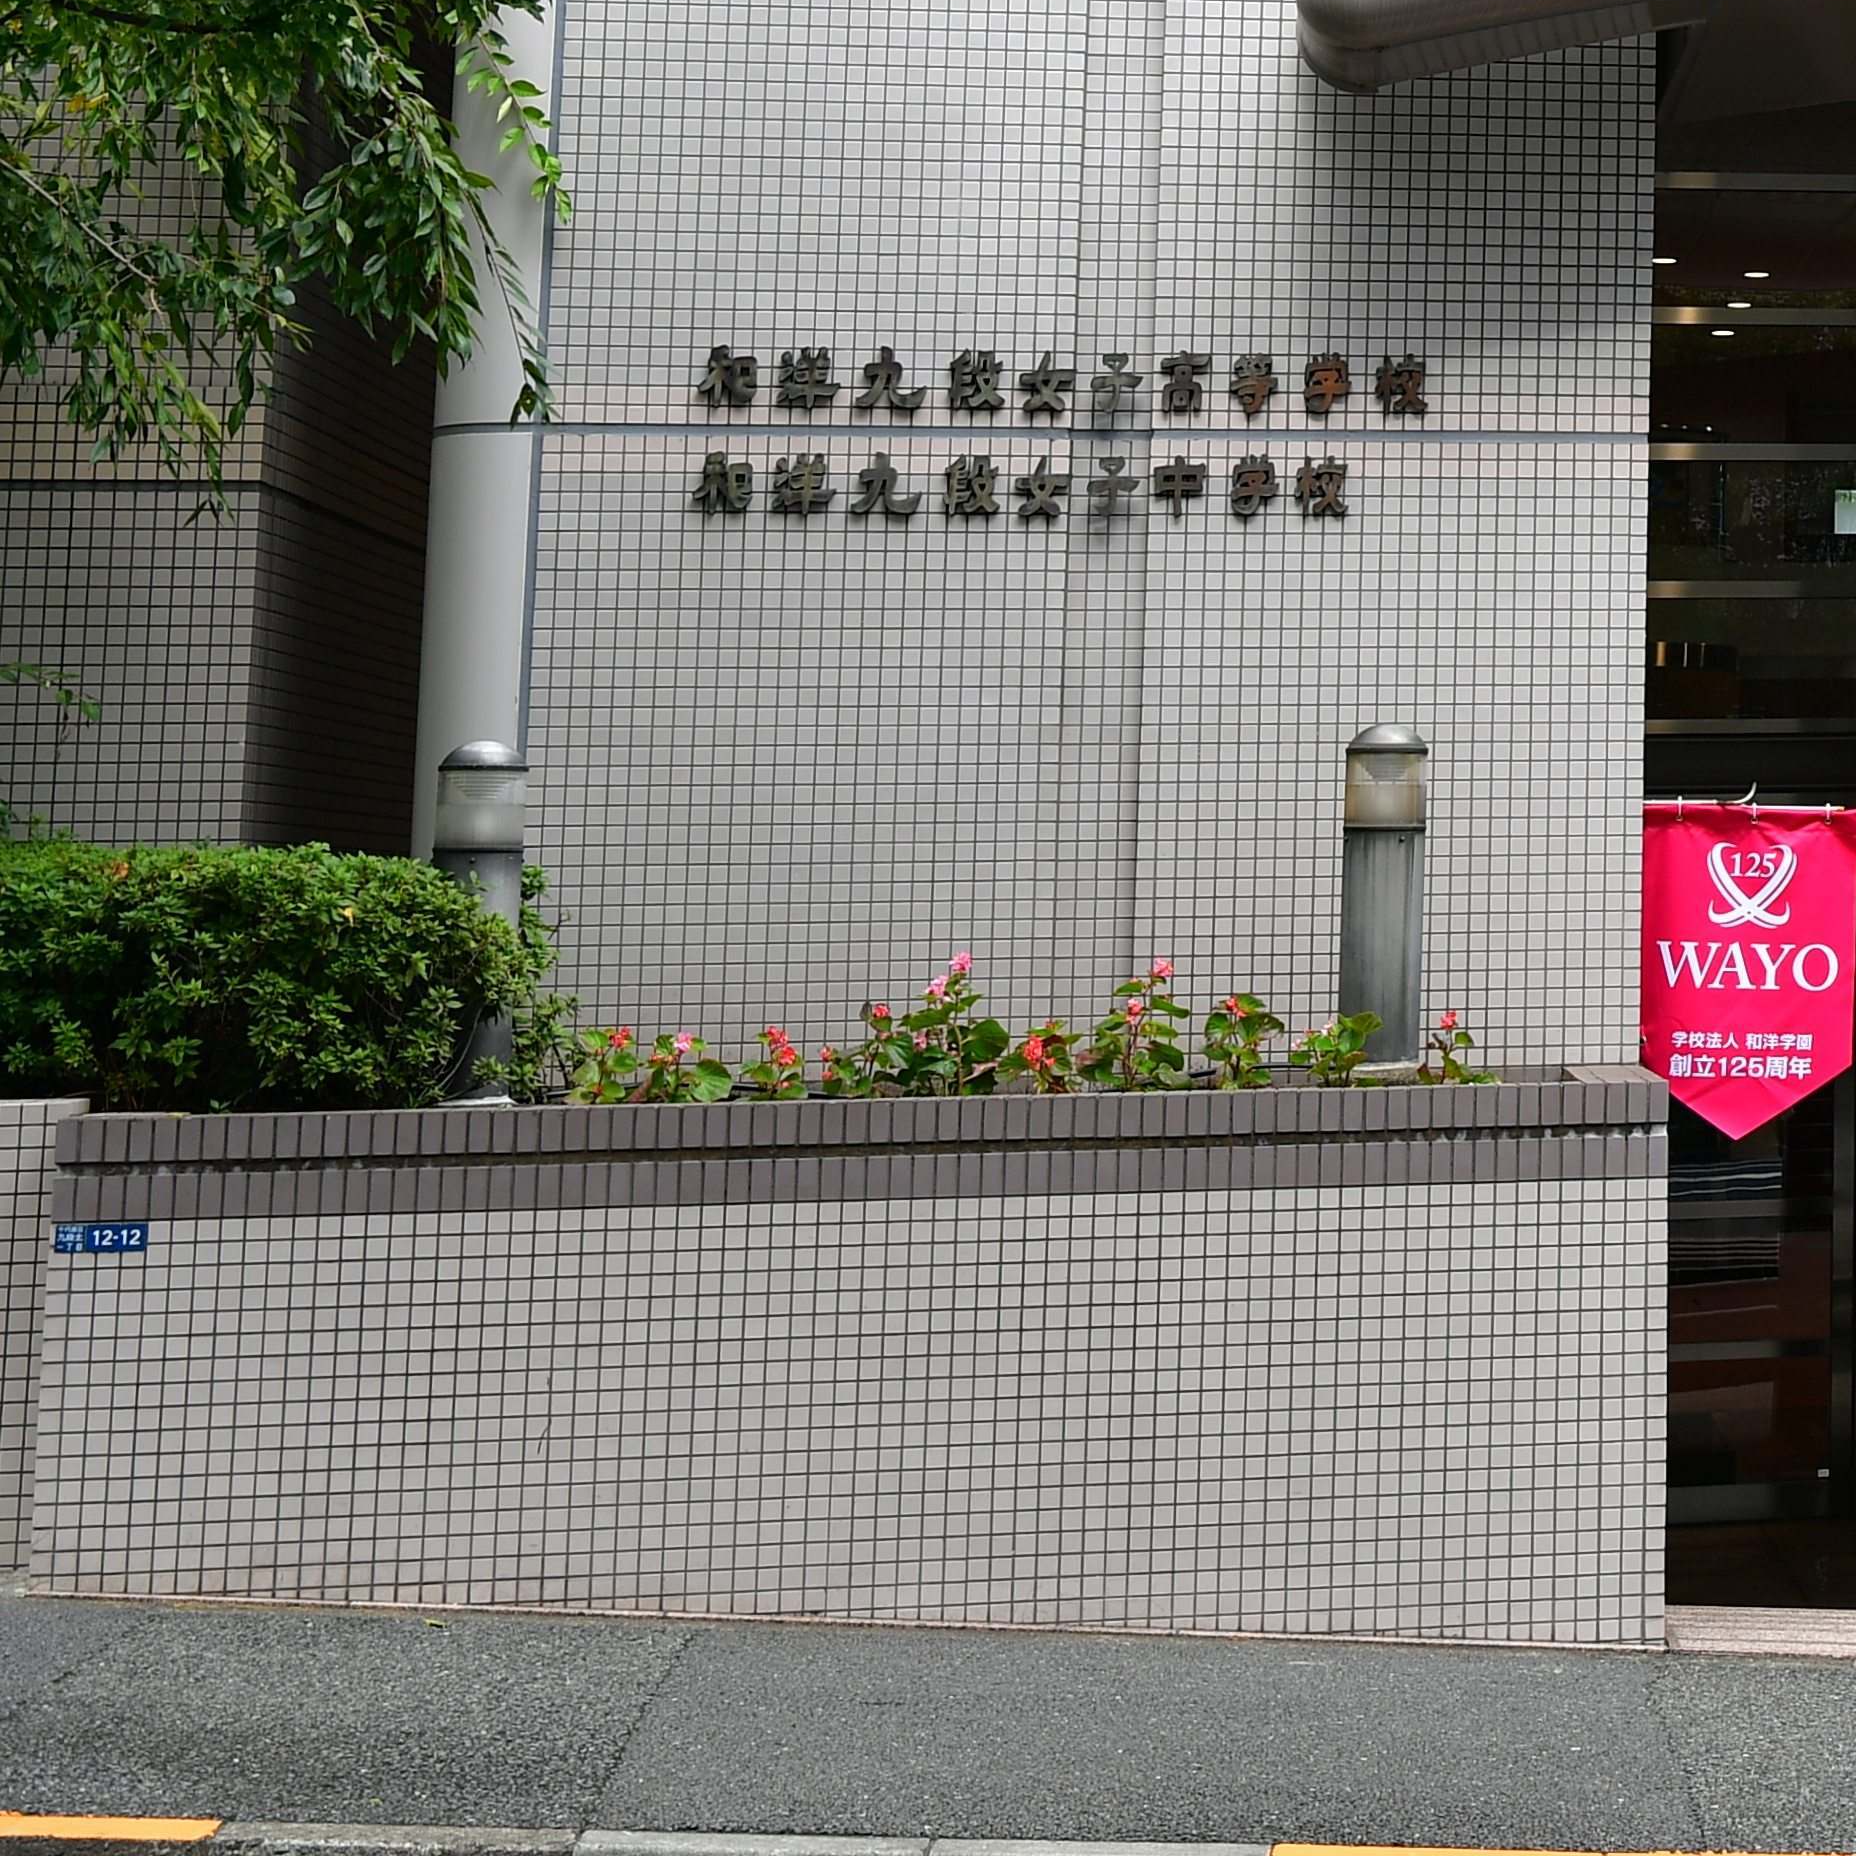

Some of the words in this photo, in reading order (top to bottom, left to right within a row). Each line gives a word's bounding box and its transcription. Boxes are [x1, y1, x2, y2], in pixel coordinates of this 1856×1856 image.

[698, 345, 1430, 415] 和洋九段女子高等学校
[692, 451, 1350, 518] 和洋九段女子中学校
[1730, 853, 1777, 878] 125
[1656, 940, 1839, 992] WAYO
[1671, 1031, 1739, 1049] 学校法人
[1745, 1033, 1813, 1051] 和洋学園
[1669, 1054, 1813, 1080] 創立125周年
[92, 1228, 142, 1246] 12-12
